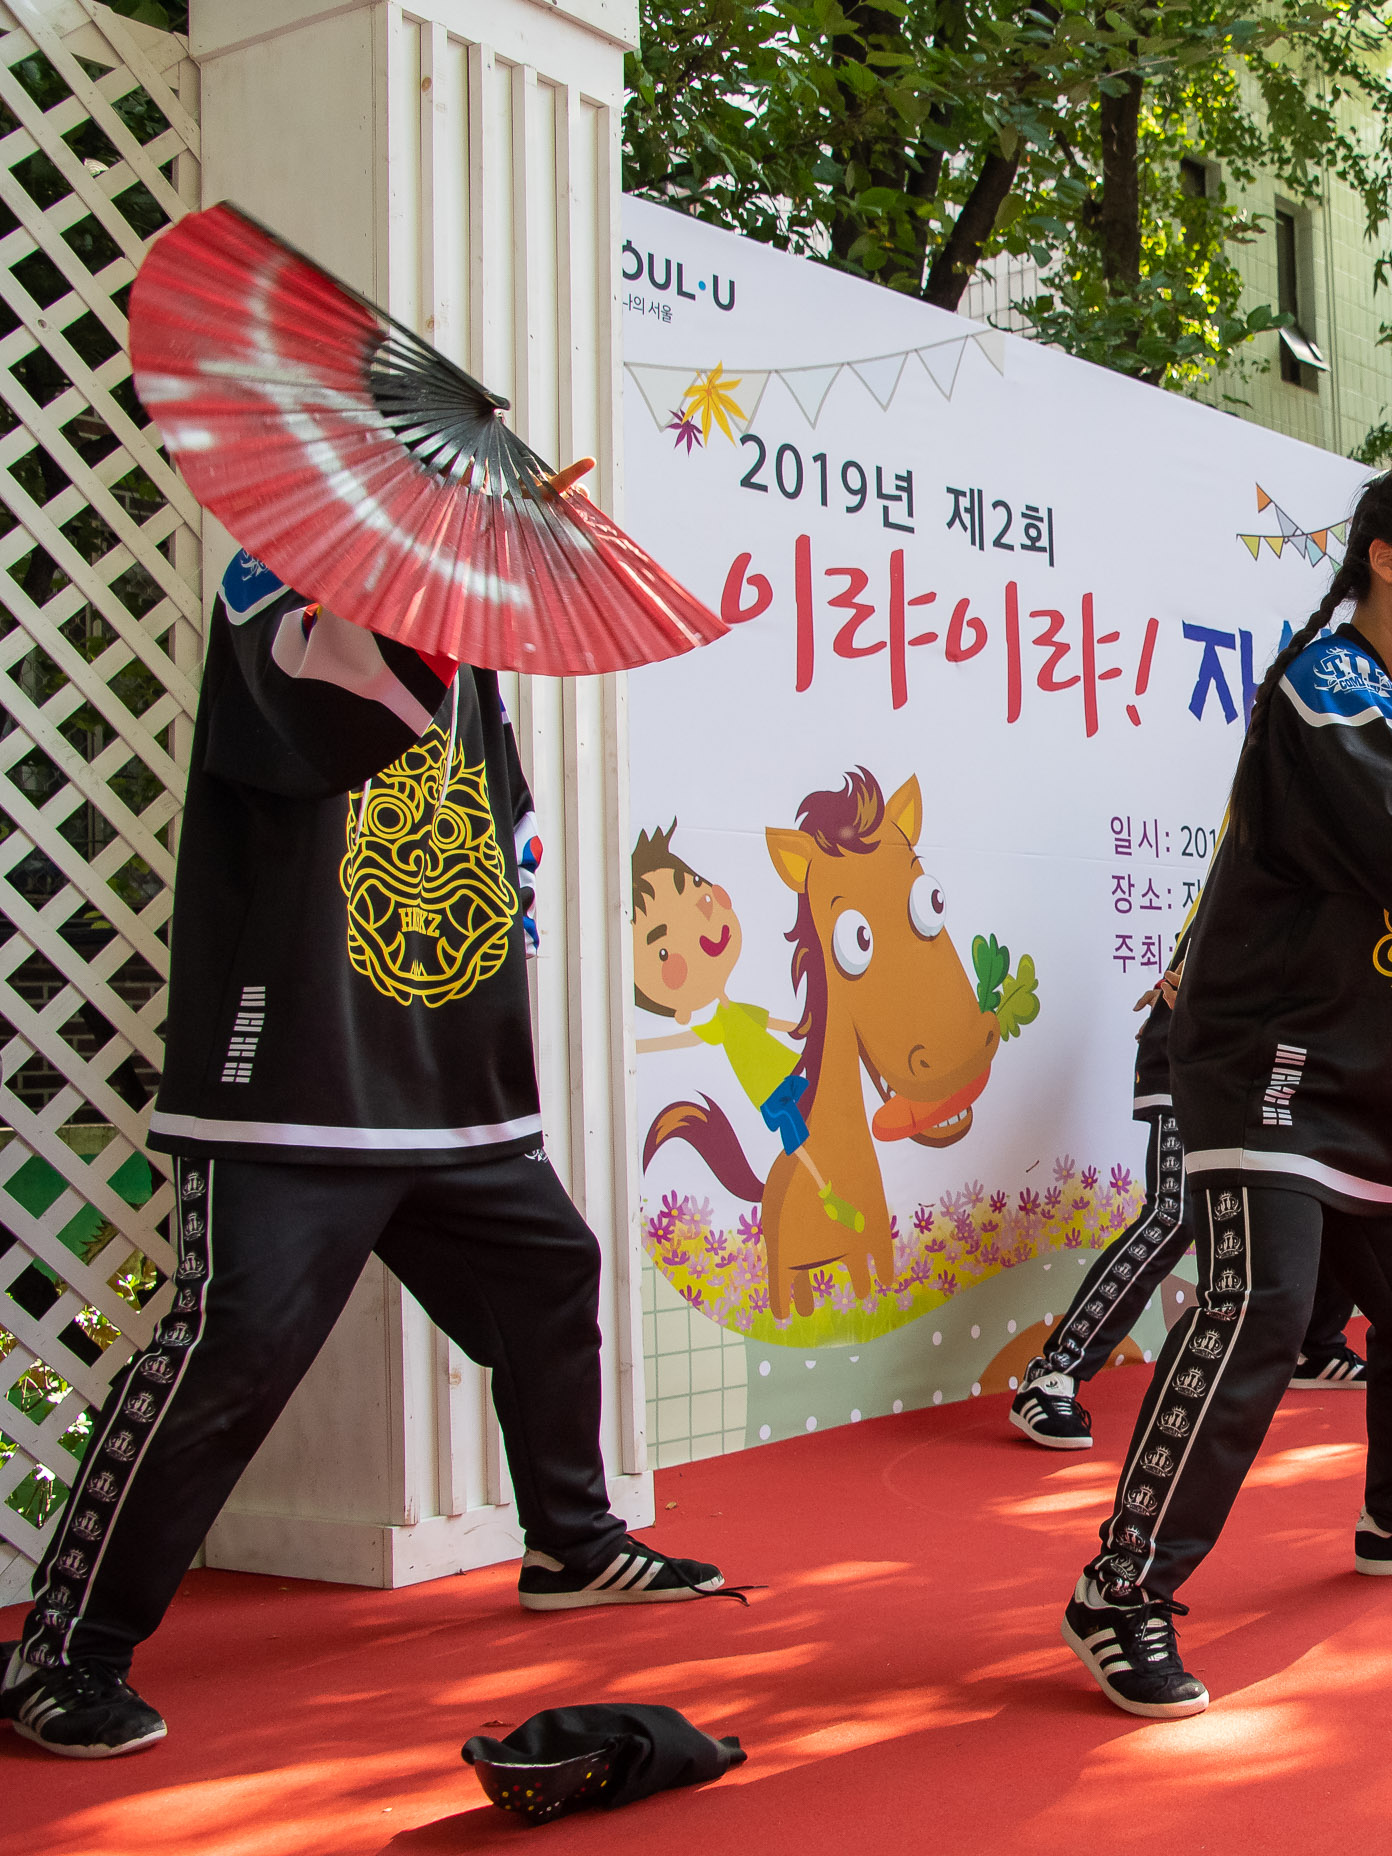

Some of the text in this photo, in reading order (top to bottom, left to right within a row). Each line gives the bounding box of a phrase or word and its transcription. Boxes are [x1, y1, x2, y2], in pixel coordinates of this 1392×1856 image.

[648, 301, 673, 324] 서울
[740, 433, 1056, 567] 2019년 제2회
[720, 534, 1159, 738] 이랴이랴!
[1110, 815, 1217, 859] 일시: 201
[1111, 873, 1172, 914] 장소:
